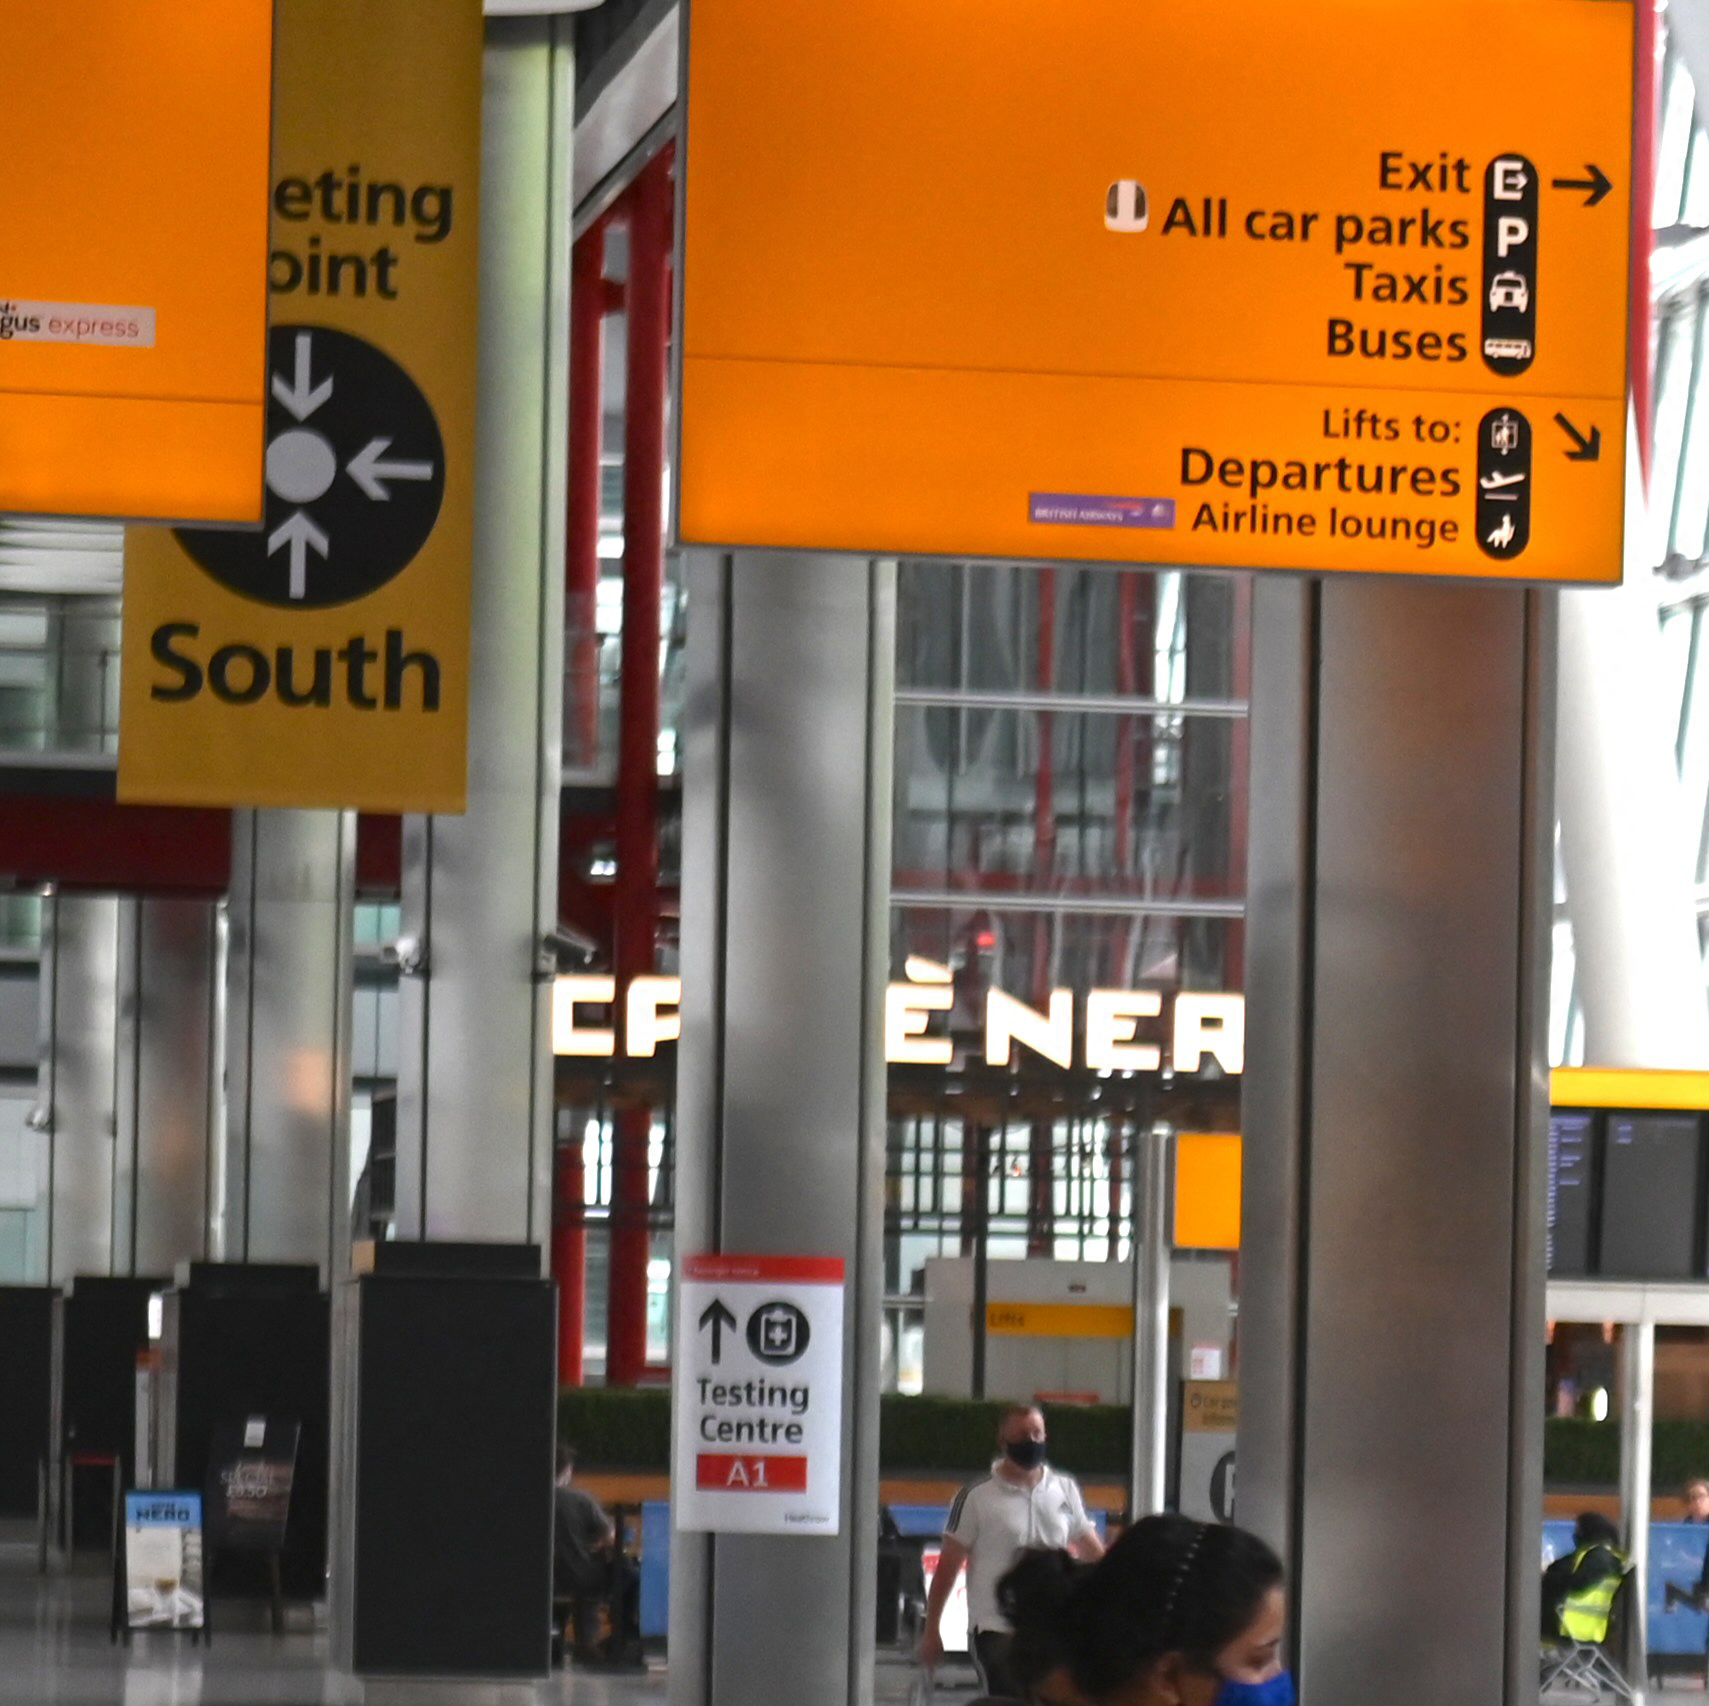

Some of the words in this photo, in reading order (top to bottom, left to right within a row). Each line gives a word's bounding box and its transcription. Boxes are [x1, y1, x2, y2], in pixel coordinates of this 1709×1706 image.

[1379, 151, 1472, 195] Exit
[273, 165, 453, 244] eting
[1161, 197, 1228, 238] All
[1244, 208, 1318, 243] car
[1335, 205, 1471, 255] parks
[270, 236, 398, 300] oint
[1344, 261, 1469, 306] Taxis
[48, 316, 140, 338] express
[1327, 320, 1468, 363] Buses
[1323, 409, 1400, 444] Lifts
[1412, 413, 1462, 445] to:
[1180, 447, 1461, 498] Departures
[1192, 504, 1317, 537] Airline
[1328, 506, 1459, 548] lounge
[150, 622, 441, 712] South
[987, 984, 1245, 1074] NER
[697, 1378, 810, 1415] Testing
[700, 1415, 804, 1444] Centre
[726, 1461, 768, 1488] A1
